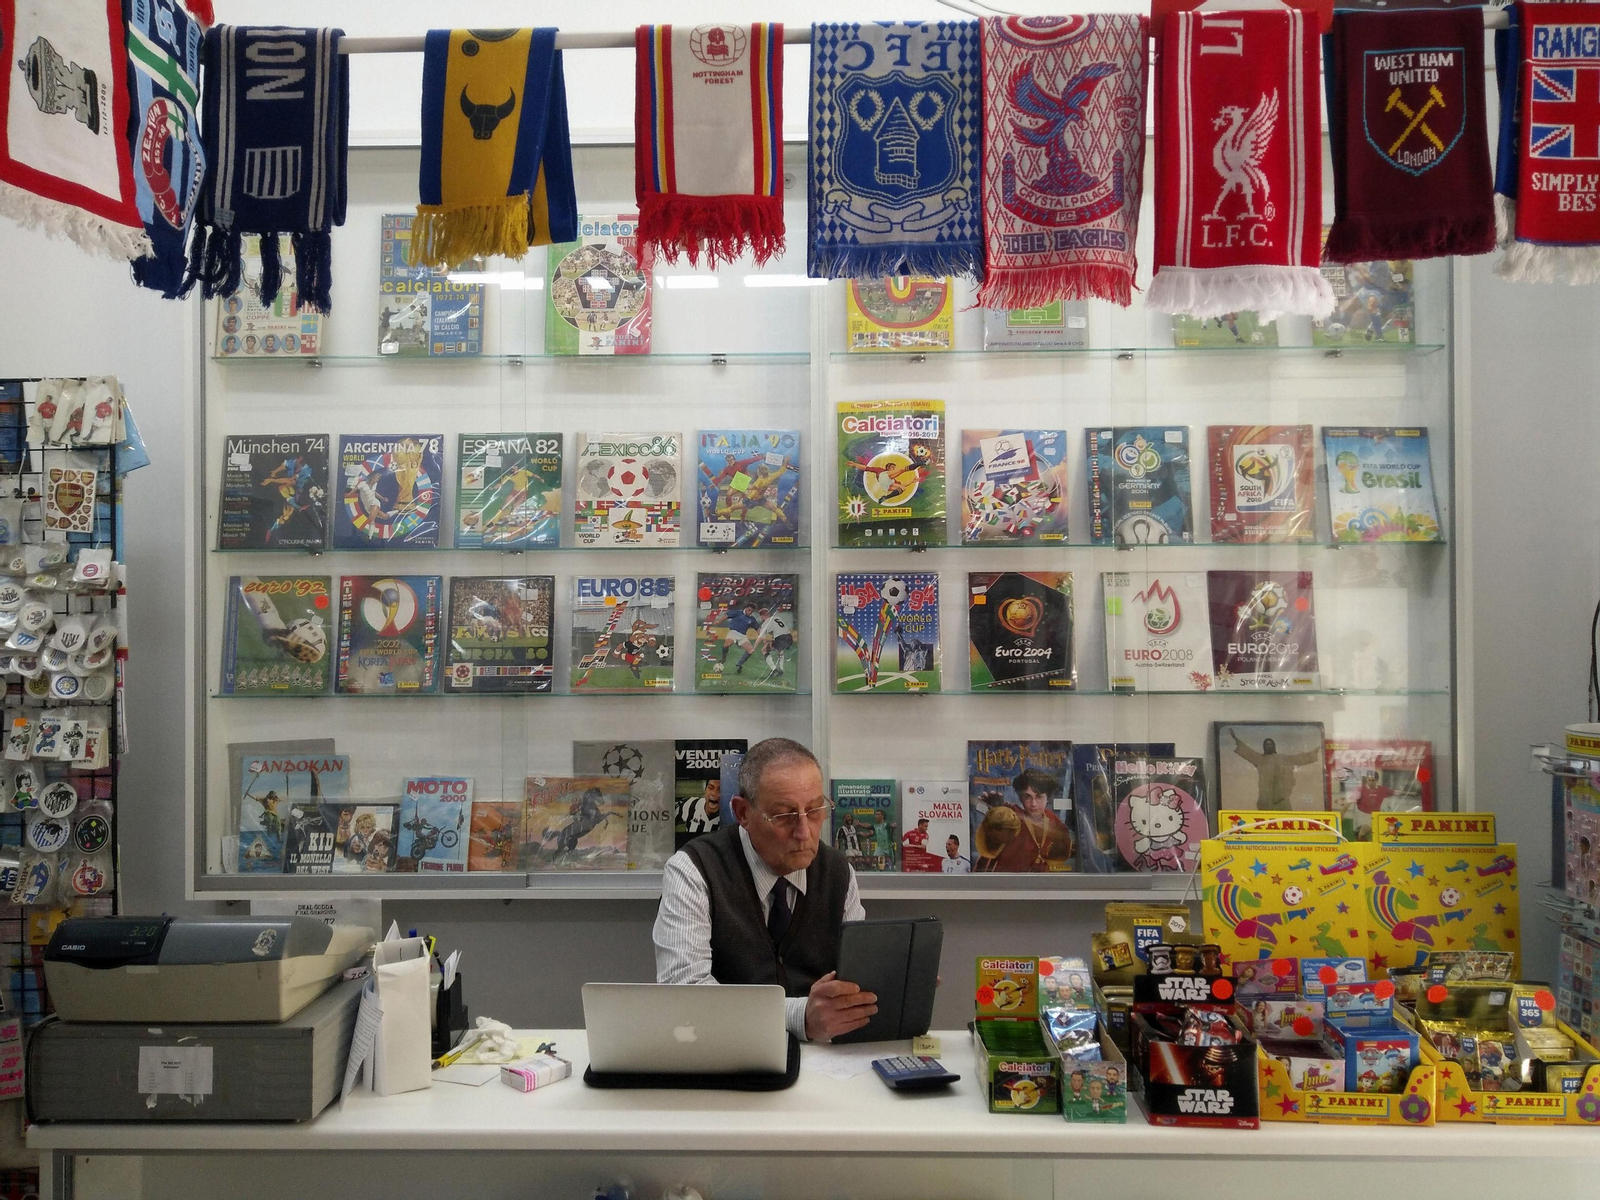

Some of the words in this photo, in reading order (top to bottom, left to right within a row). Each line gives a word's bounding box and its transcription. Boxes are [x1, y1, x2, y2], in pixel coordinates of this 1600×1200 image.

[1534, 27, 1600, 58] RANG
[1375, 54, 1415, 71] WEST
[1419, 52, 1454, 68] HAM
[692, 70, 744, 80] NOTTINGHAM
[704, 76, 735, 85] FOREST
[1390, 68, 1439, 85] UNITED
[1397, 146, 1437, 167] LONDON
[1532, 172, 1600, 192] SIMPLY
[1018, 187, 1069, 208] CRYSTAL
[1070, 183, 1112, 206] PALACE
[1558, 193, 1600, 212] BES
[1004, 235, 1047, 253] THE
[1054, 229, 1126, 250] EAGLES
[1202, 225, 1274, 248] L.F.C.
[383, 279, 479, 293] calciatori
[843, 416, 938, 432] Calciatori
[228, 439, 300, 454] München
[306, 438, 325, 453] 74
[344, 442, 415, 453] ARGENTINA
[418, 438, 439, 454] 78
[701, 433, 763, 448] ITALIA
[536, 440, 558, 454] 82
[988, 461, 1016, 469] FRANCE
[1362, 471, 1422, 488] Brasil
[1119, 482, 1161, 490] GERMANY
[244, 581, 293, 595] euro
[577, 578, 637, 597] EURO
[639, 578, 670, 597] 88
[841, 581, 880, 608] USA
[899, 615, 932, 623] WORLD
[906, 624, 925, 633] CUP
[377, 640, 400, 648] 2002
[995, 645, 1022, 657] Euro
[1024, 647, 1052, 659] 2004
[358, 657, 388, 667] KOREA
[686, 760, 720, 769] 2000
[974, 748, 1018, 773] Harry
[1018, 745, 1067, 771] Potter
[248, 760, 344, 773] SANDOKAN
[1115, 761, 1156, 774] Hello
[1156, 761, 1197, 777] Kitty
[407, 781, 468, 794] MOTO
[871, 785, 891, 794] 2017
[838, 797, 891, 808] CALCIO
[933, 803, 962, 811] MALTA
[918, 810, 962, 819] SLOVAKIA
[1254, 818, 1331, 831] PANINI
[1411, 819, 1490, 832] PANINI
[309, 833, 334, 851] KID
[290, 854, 298, 863] IL
[300, 854, 332, 863] MONELLO
[1212, 854, 1230, 866] PANINI
[1369, 856, 1387, 868] PANINI
[1324, 878, 1342, 890] PANINI
[1481, 880, 1499, 892] PANINI
[1170, 920, 1185, 930] 2017
[1137, 929, 1159, 937] FIFA
[982, 960, 1034, 970] Calciatori
[1158, 977, 1210, 989] STAR
[1158, 988, 1210, 1000] WARS
[1521, 1009, 1540, 1017] 365
[999, 1062, 1050, 1073] Calciatori
[1177, 1089, 1234, 1101] STAR
[1178, 1101, 1234, 1114] WARS
[1328, 1096, 1384, 1108] PANINI
[1505, 1097, 1561, 1107] PANINI
[1238, 1119, 1254, 1128] Disney
